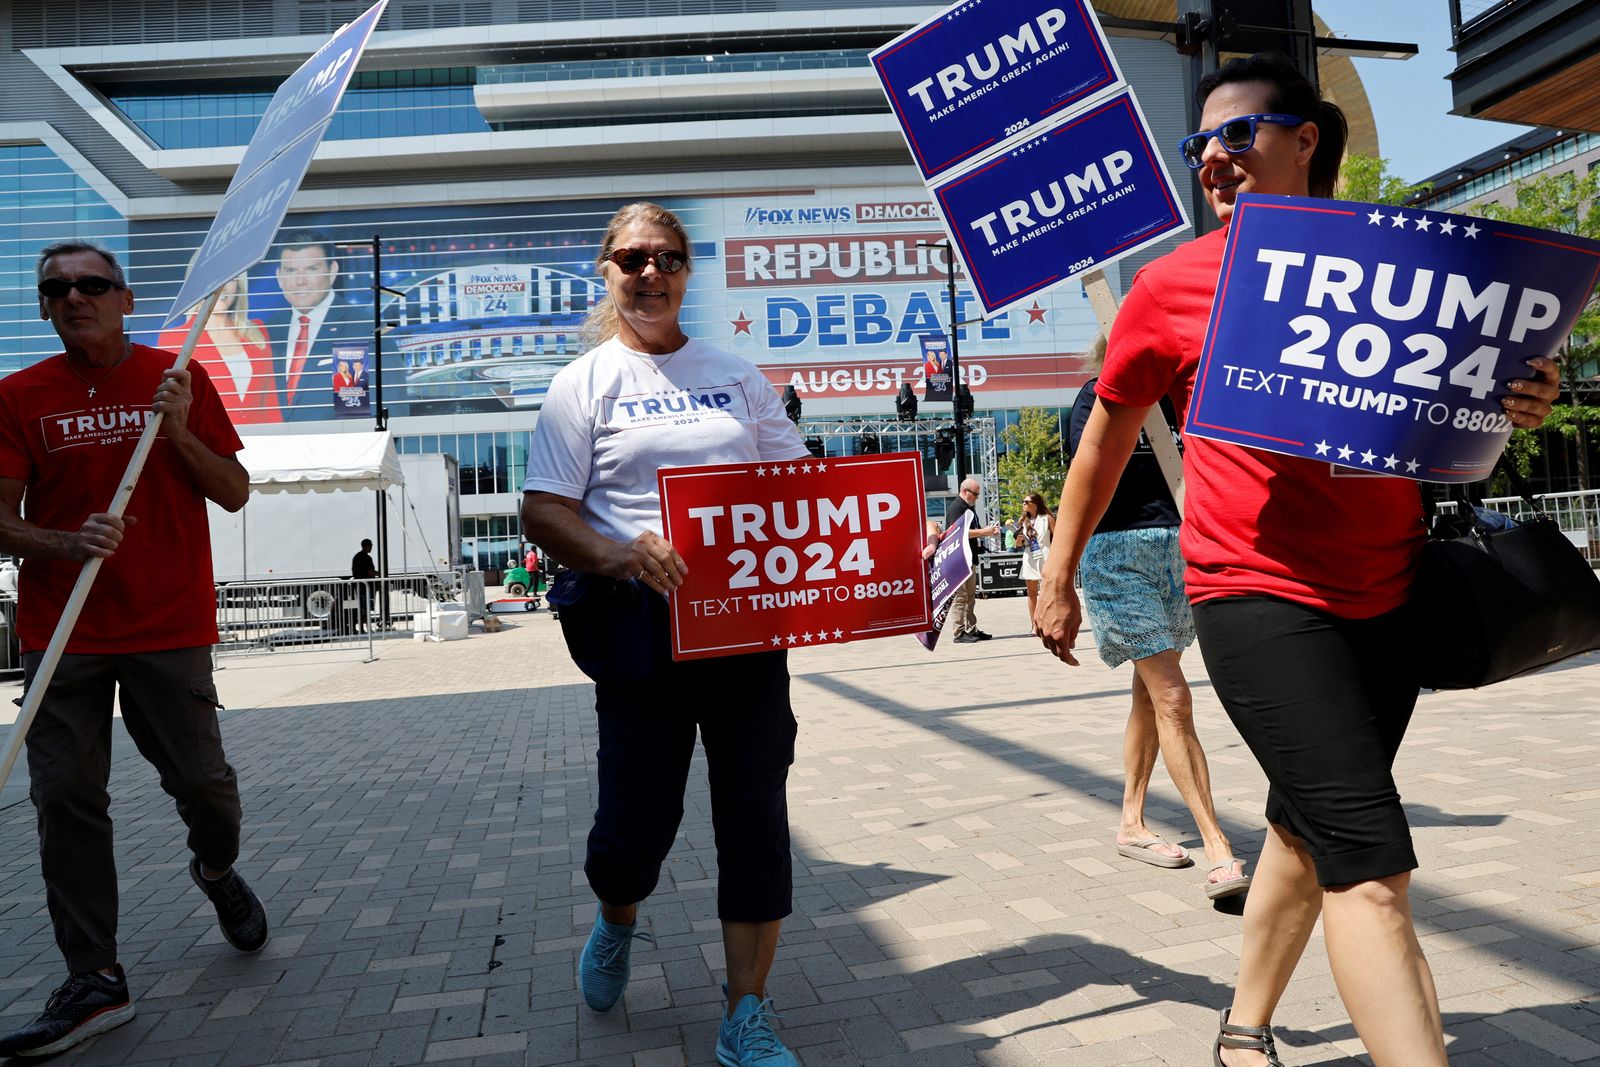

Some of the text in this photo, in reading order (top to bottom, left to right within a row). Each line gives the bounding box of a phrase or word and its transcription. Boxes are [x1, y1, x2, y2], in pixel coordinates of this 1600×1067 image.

[907, 8, 1067, 112] TRUMP
[264, 47, 353, 132] TRUMP
[929, 42, 1070, 123] MAKE AMERICA GREAT AGAIN!
[1004, 117, 1030, 136] 2024
[205, 178, 291, 257] TRUMP
[757, 204, 938, 225] FOX NEWS DEMOCR
[970, 150, 1133, 246] TRUMP
[991, 183, 1136, 257] MAKE AMERICA GREAT AGAIN!
[475, 274, 518, 284] FOX NEWS
[744, 239, 962, 281] REPUBLIC
[1068, 256, 1095, 274] 2024
[466, 283, 522, 294] DEMOCRACY
[484, 294, 508, 312] 24
[1256, 248, 1561, 344] TRUMP
[766, 291, 1011, 349] DEBATE
[1279, 314, 1501, 400] 2024
[789, 366, 906, 393] AUGUST
[1223, 365, 1294, 396] TEXT
[1300, 378, 1408, 416] TRUMP
[1412, 399, 1449, 425] TO
[619, 392, 732, 418] TRUMP
[673, 418, 700, 426] 2024
[100, 436, 123, 445] 2024
[688, 493, 901, 547] TRUMP
[727, 538, 875, 590] 2024
[934, 538, 960, 567] TEAM
[689, 596, 743, 617] TEXT
[748, 589, 820, 611] TRUMP
[820, 585, 850, 603] TO
[853, 578, 915, 600] 88022
